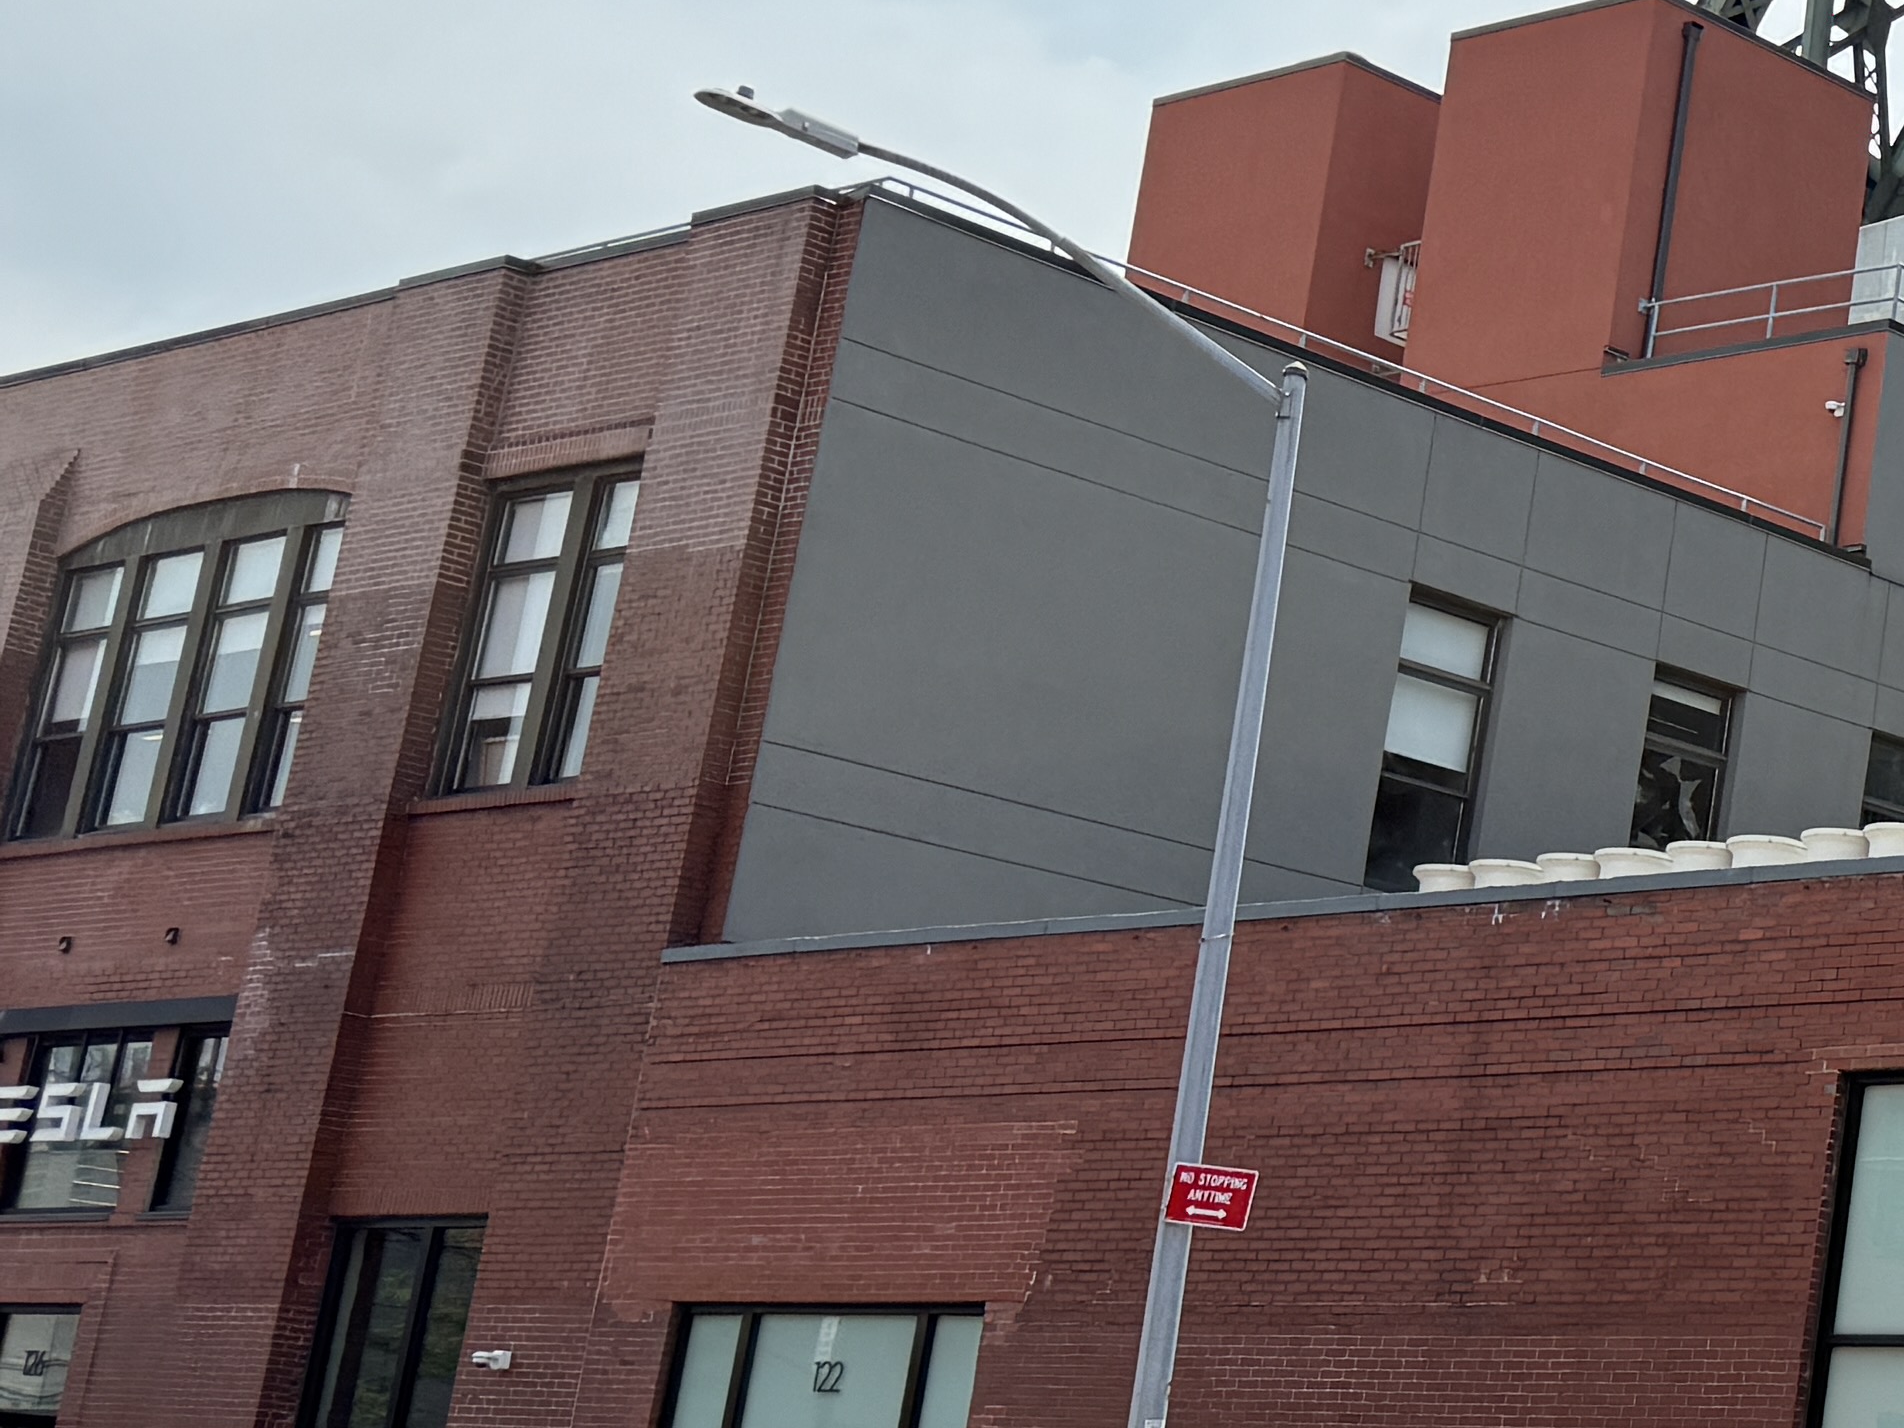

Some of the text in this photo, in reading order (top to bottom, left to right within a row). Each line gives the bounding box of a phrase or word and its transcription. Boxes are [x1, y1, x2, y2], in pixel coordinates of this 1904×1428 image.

[1180, 1173, 1247, 1190] NO STOPPING
[1188, 1190, 1233, 1204] ANYTIME
[23, 1350, 46, 1376] 126
[813, 1361, 845, 1393] 122
